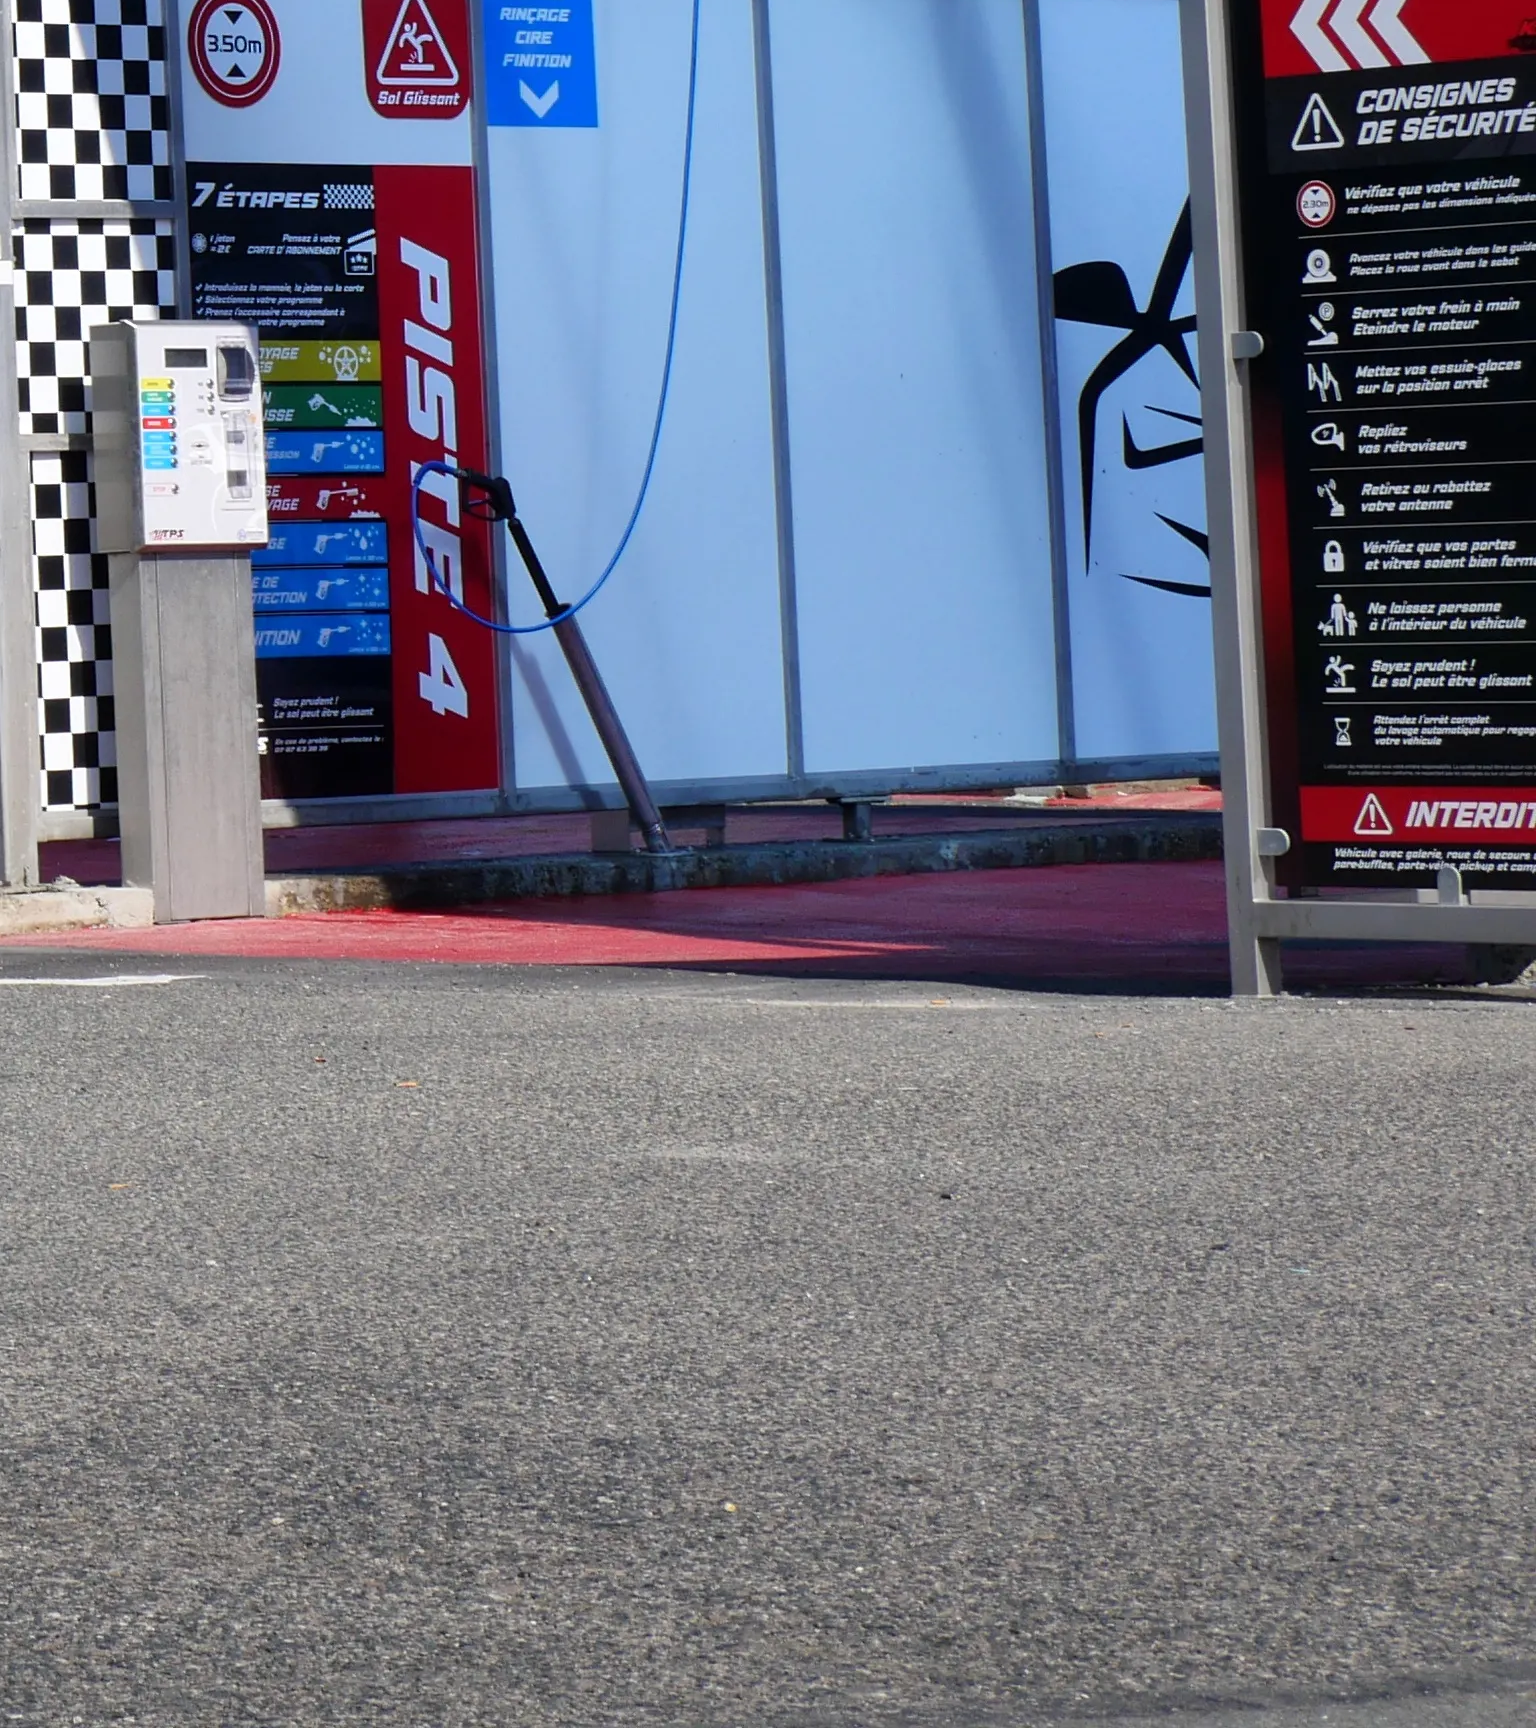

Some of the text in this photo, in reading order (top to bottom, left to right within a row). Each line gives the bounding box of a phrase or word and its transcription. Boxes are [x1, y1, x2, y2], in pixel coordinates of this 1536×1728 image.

[500, 8, 571, 25] RINÇAGE
[207, 34, 262, 56] 3.50m
[515, 30, 553, 46] CIRE
[502, 53, 572, 69] FINITION
[378, 90, 460, 107] Sol Glissant
[1356, 77, 1516, 114] CONSIGNES
[1357, 101, 1536, 145] DE SÉCURITÉ
[192, 182, 320, 208] 7 ÉTAPES
[1344, 175, 1520, 200] Vérifiez que votre véhicule
[1393, 250, 1419, 260] votre
[1421, 246, 1463, 259] véhicule
[1465, 244, 1489, 255] dans
[1352, 297, 1520, 319] Serrez votre frein à main
[1353, 318, 1480, 335] Eteindre le moteur
[1355, 359, 1522, 378] Mettez vos essuie-glaces
[1357, 376, 1489, 395] sur la position arrêt
[1358, 423, 1408, 440] Repliez
[1358, 438, 1467, 454] vos rétroviseurs
[400, 236, 469, 719] PISTE 4
[1361, 480, 1491, 496] Retirez ou rabattez
[1361, 499, 1453, 512] votre antenne
[1363, 539, 1516, 555] Vérifiez que vos portes
[1365, 554, 1497, 570] et vitres soient bien
[1368, 600, 1502, 615] Ne laissez personne
[1369, 615, 1526, 631] à l'intérieur du véhicule
[1371, 659, 1467, 675] Soyez prudent
[1371, 673, 1532, 690] Le sol peut être glissant
[1405, 801, 1536, 828] INTERDIT
